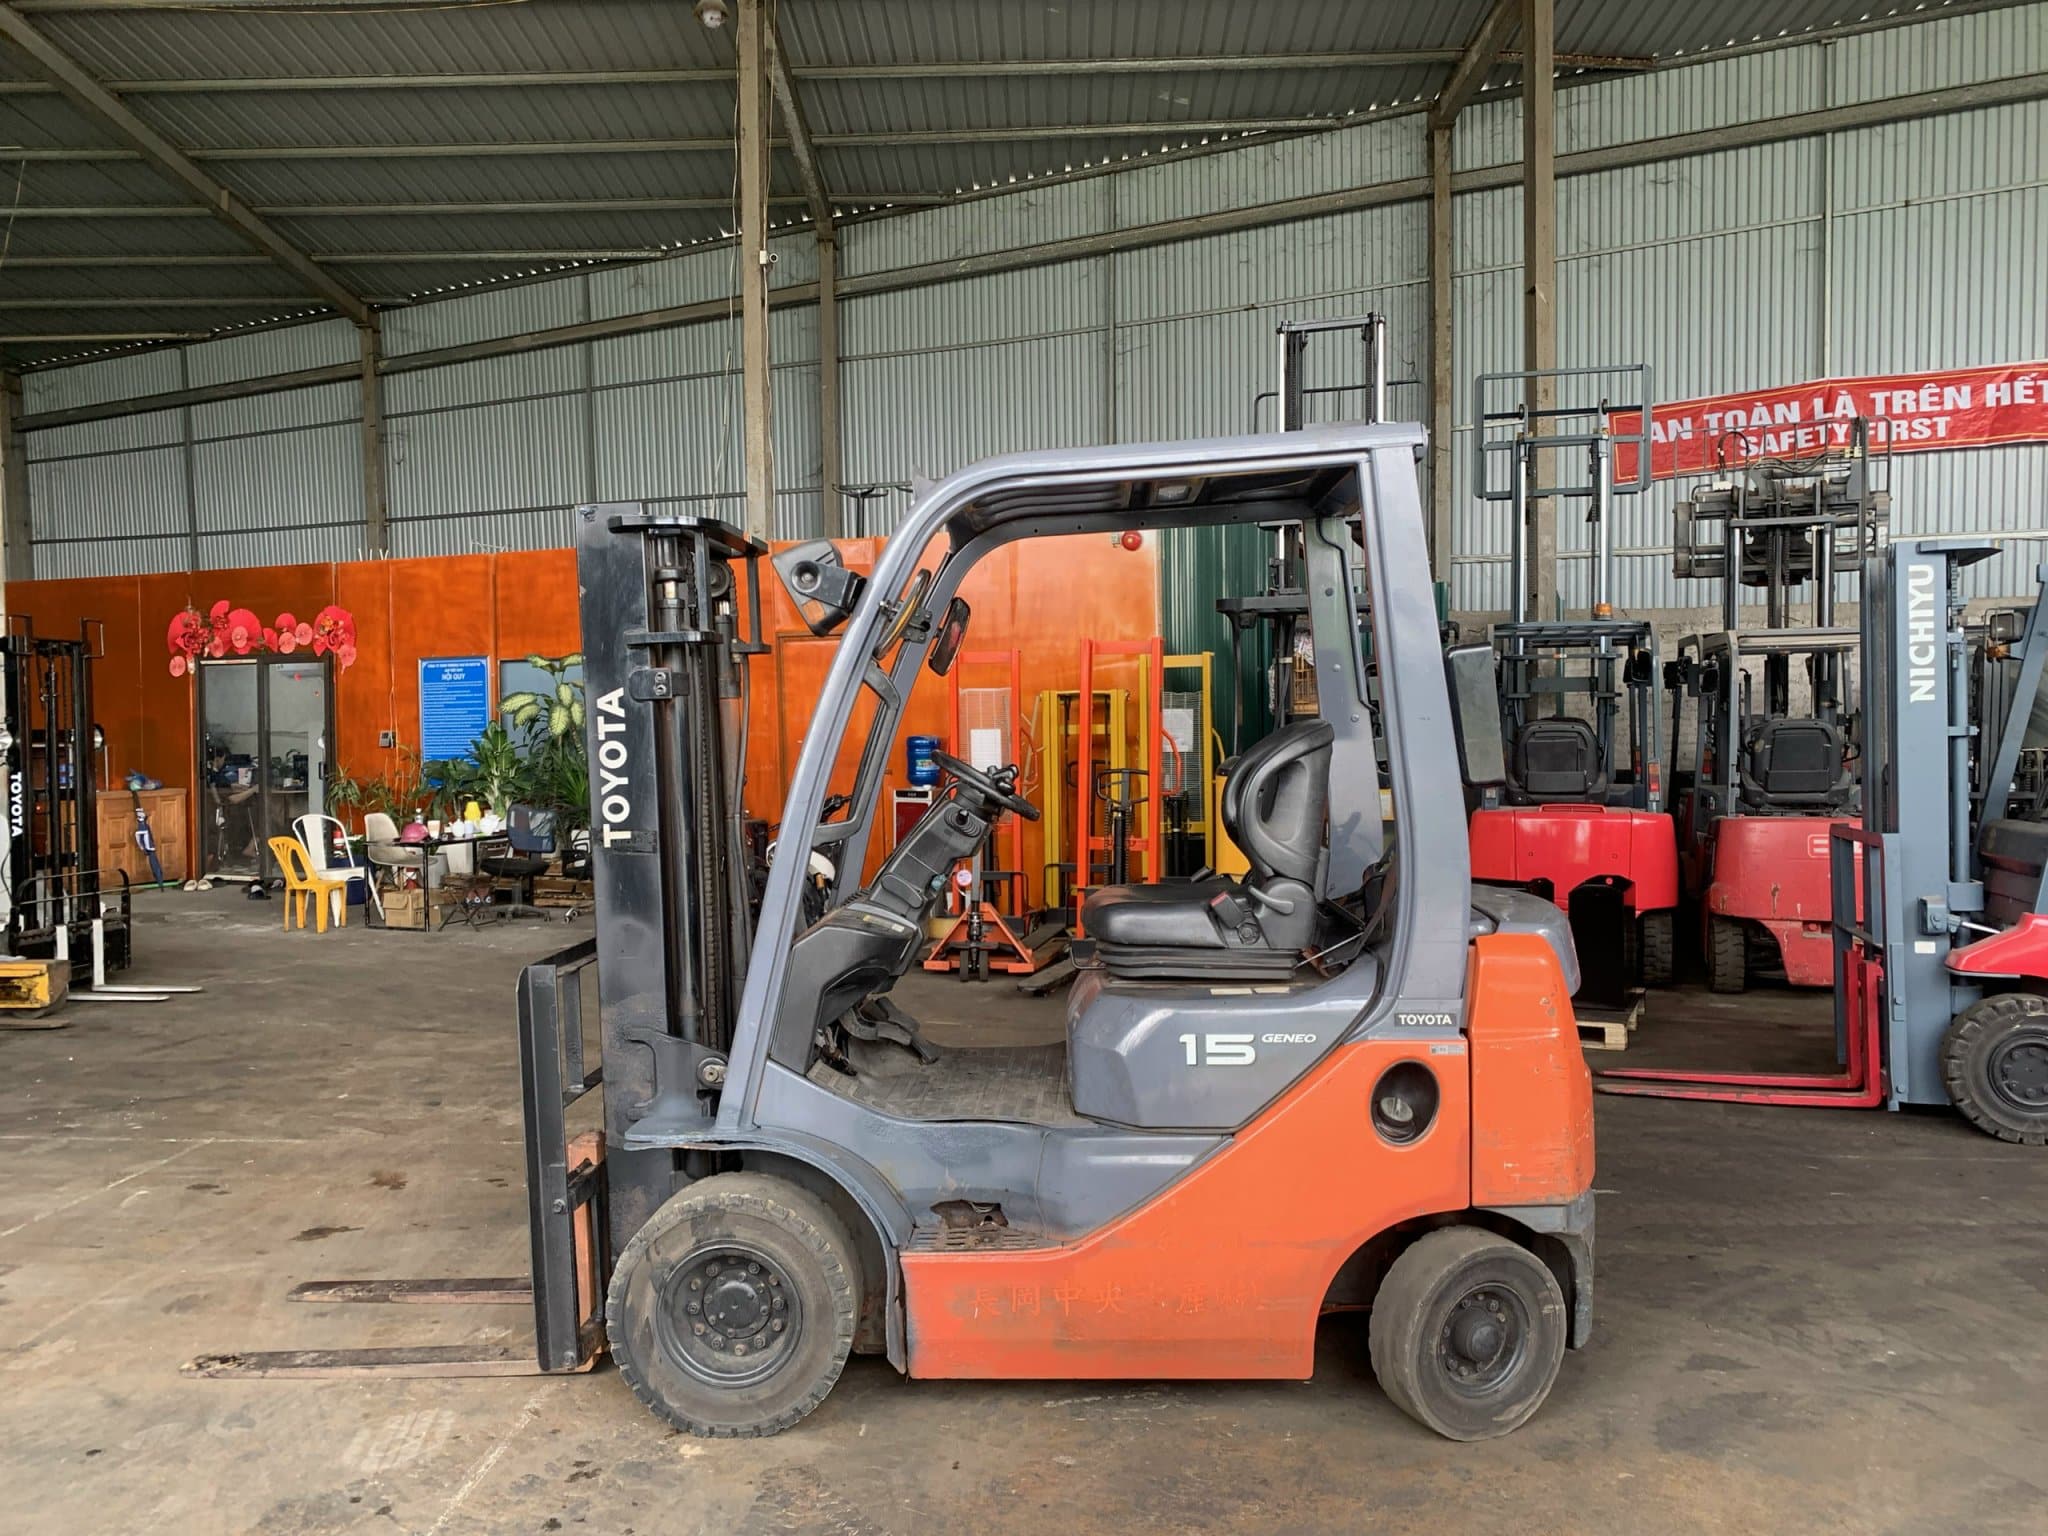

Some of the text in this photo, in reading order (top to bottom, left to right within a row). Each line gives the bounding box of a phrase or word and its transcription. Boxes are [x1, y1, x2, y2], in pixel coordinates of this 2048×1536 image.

[1651, 373, 2048, 443] AN TOÀN LÀ TRÊN HẾT
[1739, 422, 1849, 457] SAFETY
[1908, 564, 1936, 703] NICHIYU
[597, 687, 632, 848] TOYOTA
[10, 772, 23, 837] TOYOTA
[1179, 1033, 1317, 1065] 15 GENEO
[1399, 1014, 1452, 1025] TOYOTA
